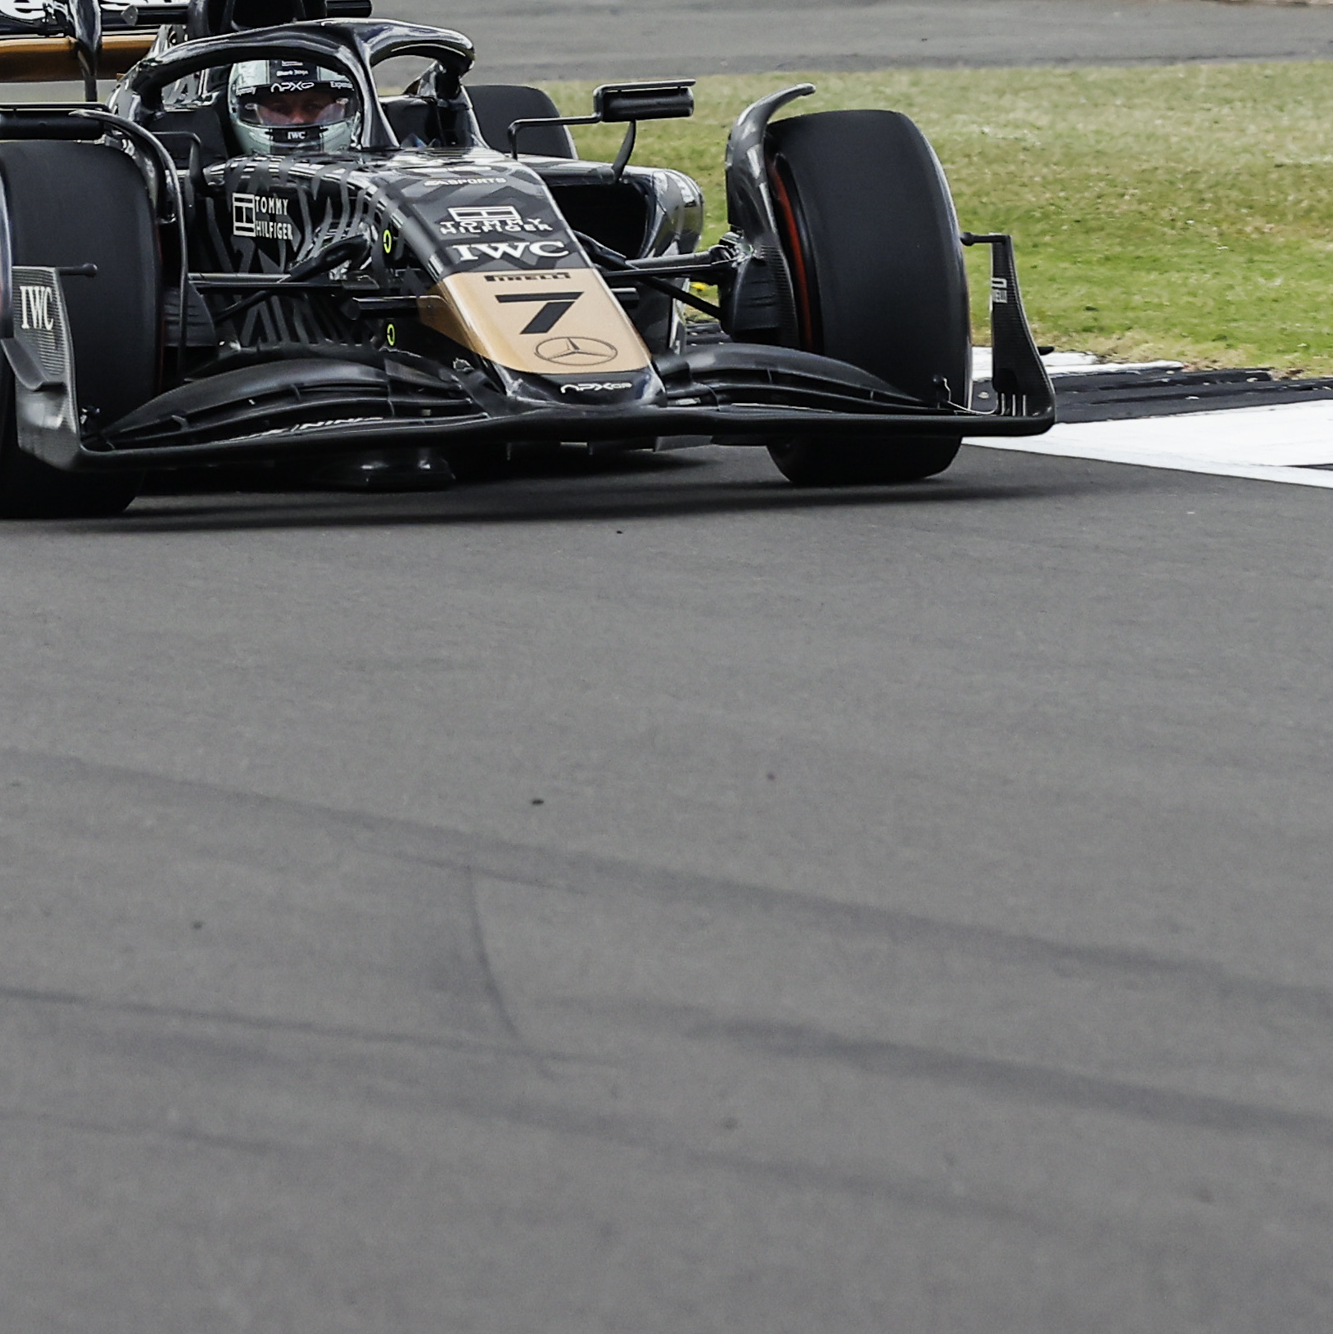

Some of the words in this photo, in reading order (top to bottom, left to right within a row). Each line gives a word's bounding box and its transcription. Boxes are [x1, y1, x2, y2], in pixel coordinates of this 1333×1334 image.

[287, 131, 306, 140] IWC
[254, 195, 289, 216] TOMMY
[255, 220, 293, 241] HILFIGER
[439, 218, 543, 227] TOMMY
[439, 224, 554, 235] HILFIGER
[451, 241, 569, 261] IWC
[19, 285, 55, 331] IWC
[495, 291, 585, 335] 7
